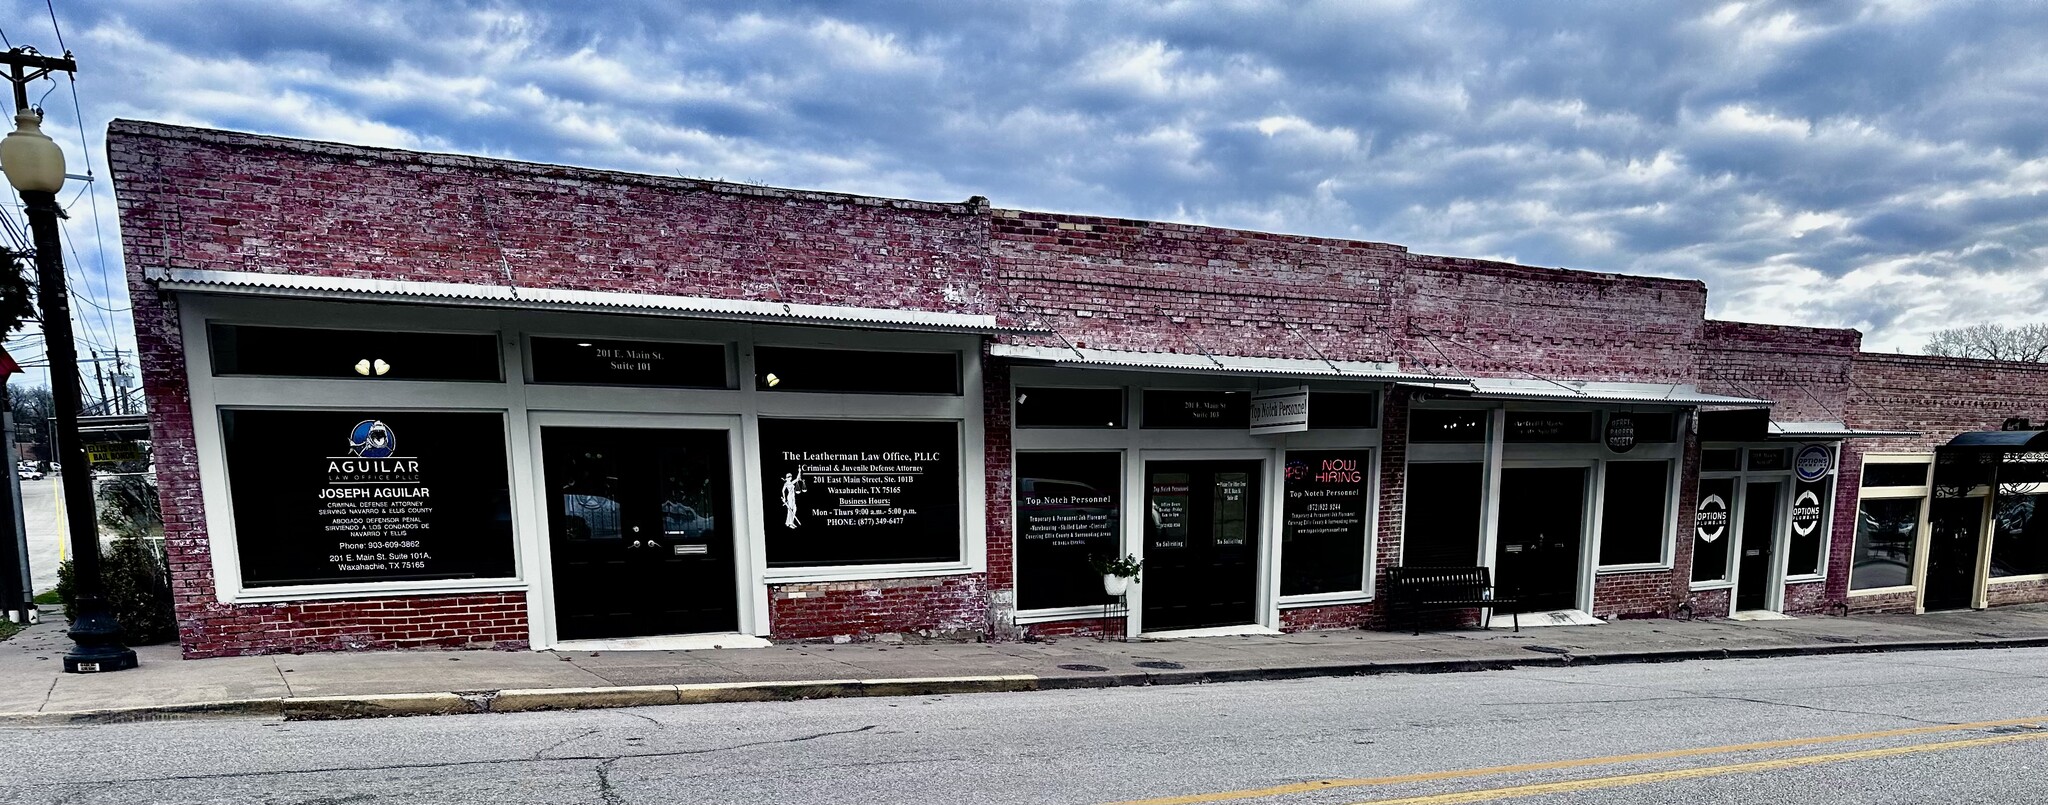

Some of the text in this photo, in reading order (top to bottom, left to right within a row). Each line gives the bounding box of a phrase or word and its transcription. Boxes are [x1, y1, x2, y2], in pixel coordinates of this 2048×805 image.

[596, 349, 664, 360] 201 E. Main St.
[610, 361, 650, 370] Suite 101
[1251, 399, 1307, 421] Top Notch Personnel
[1610, 437, 1633, 446] SOCIETY
[782, 451, 940, 461] The Leatherman Law Office, PLLC
[328, 461, 419, 473] AGUILAR
[802, 464, 832, 472] Criminal
[896, 465, 923, 473] Attorney
[1322, 459, 1357, 471] NOW
[1315, 471, 1361, 482] HIRING
[318, 488, 430, 499] JOSEPH AGUILAR
[1026, 497, 1041, 505] Top
[1697, 512, 1726, 520] OPTIONS
[1793, 507, 1819, 516] OPTIONS
[858, 518, 874, 526] (877)
[338, 563, 387, 571] Waxahachie,
